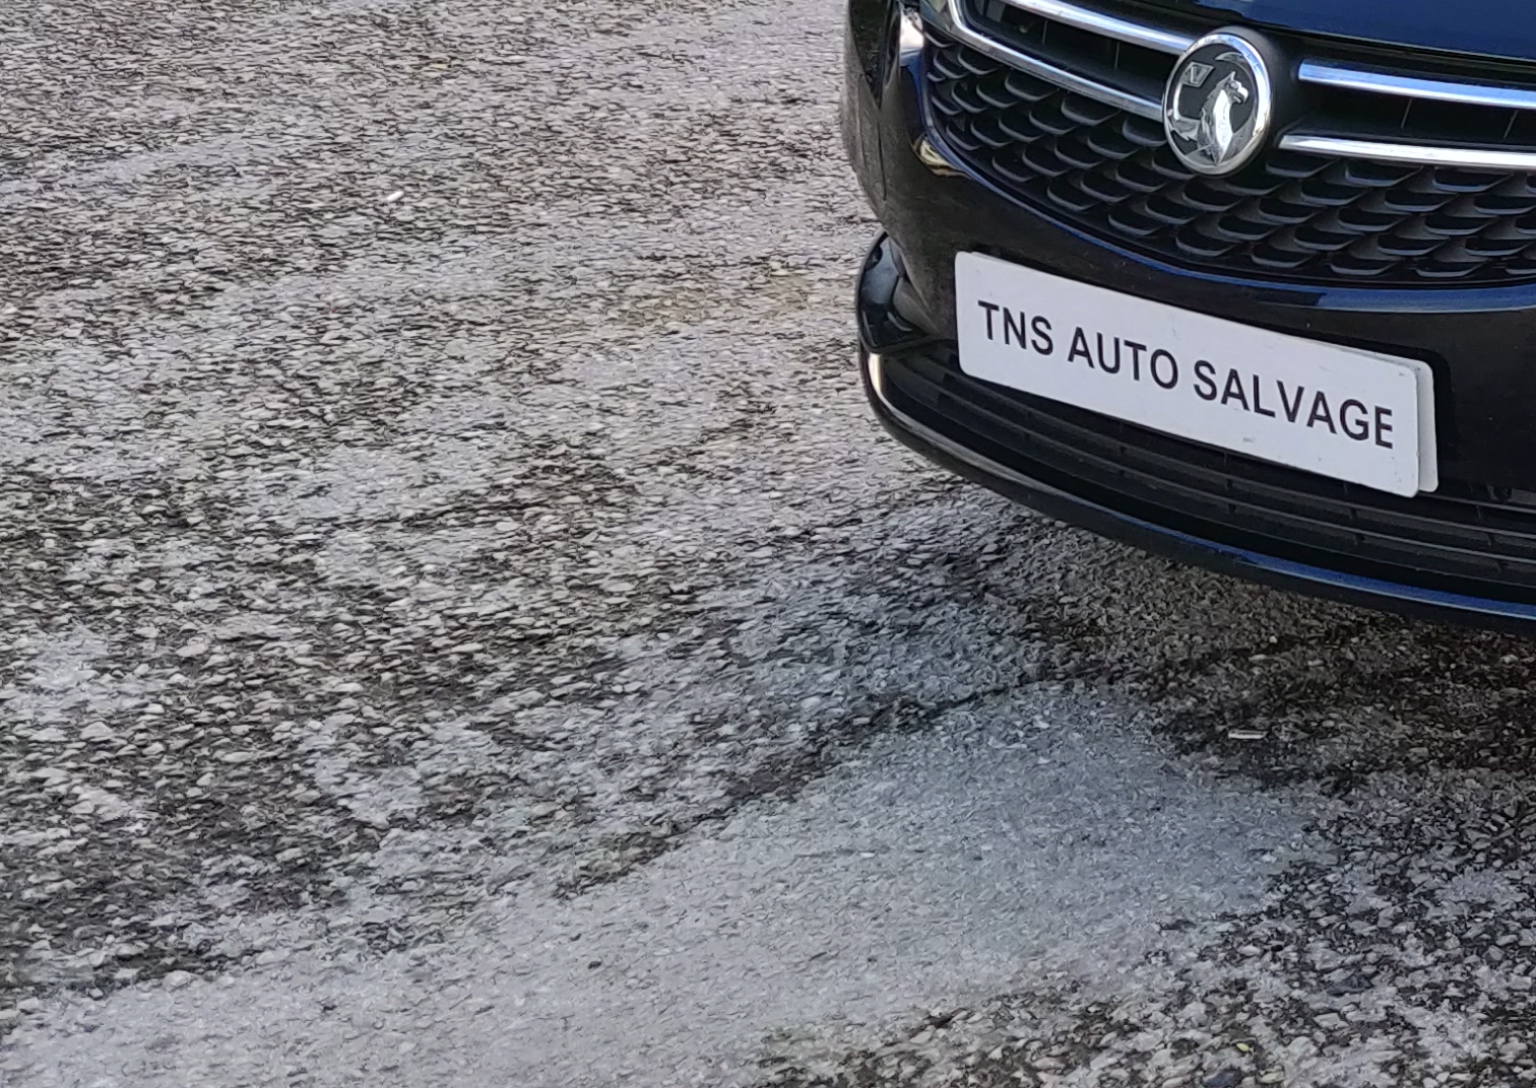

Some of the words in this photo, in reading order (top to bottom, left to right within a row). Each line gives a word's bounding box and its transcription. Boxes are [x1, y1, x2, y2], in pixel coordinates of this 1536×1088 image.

[978, 299, 1054, 356] TNS
[1067, 327, 1179, 390] AUTO
[1193, 359, 1394, 450] SALVAGE
